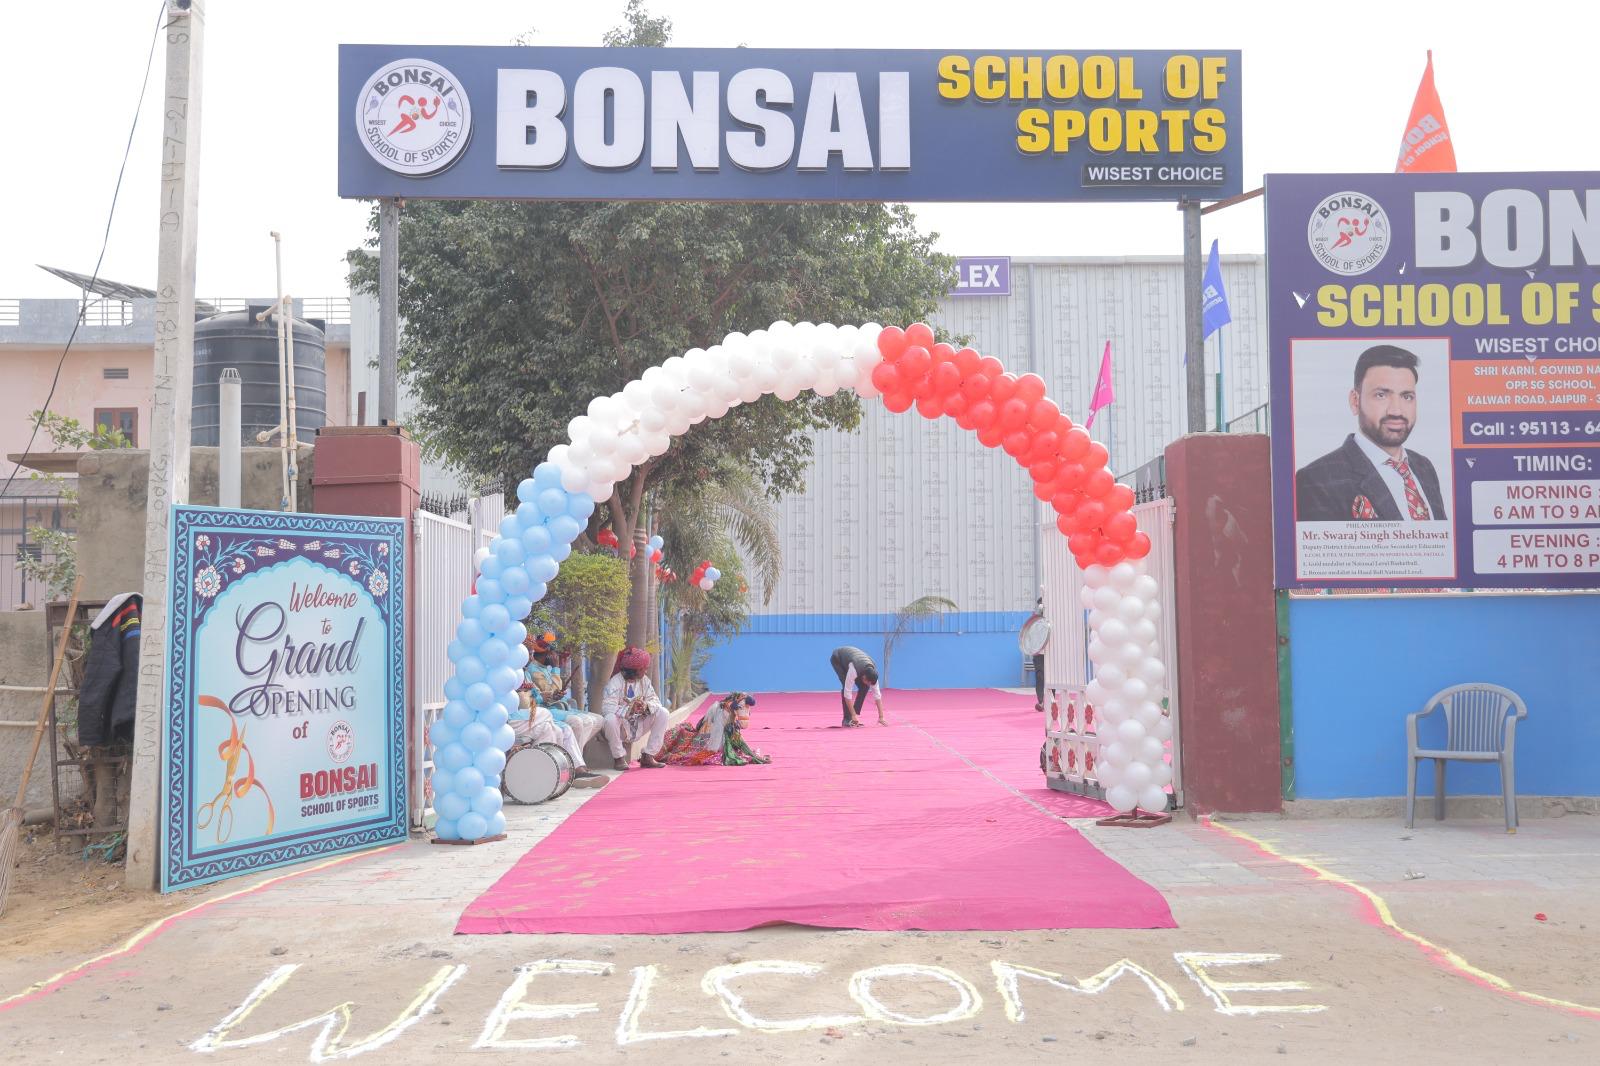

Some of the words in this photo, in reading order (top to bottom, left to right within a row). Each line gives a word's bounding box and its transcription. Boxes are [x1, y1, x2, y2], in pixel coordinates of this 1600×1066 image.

[373, 68, 454, 97] BONSAI
[937, 55, 1143, 100] SCHOOL
[1164, 55, 1228, 100] OF
[496, 67, 911, 171] BONSAI
[1017, 108, 1228, 154] SPORTS
[367, 127, 400, 161] SCHOOL
[404, 152, 418, 163] OF
[421, 130, 458, 162] SPORTS
[1088, 166, 1153, 181] WISEST
[1157, 166, 1223, 181] CHOICE
[1319, 196, 1379, 219] BONSAI
[1314, 242, 1340, 269] SCHOOL
[1343, 261, 1354, 270] OF
[1356, 243, 1384, 269] SPORTS
[1316, 283, 1510, 327] SCHOOL
[1521, 282, 1580, 326] OF
[1474, 337, 1549, 353] WISEST
[1474, 366, 1498, 376] SHRI
[1539, 365, 1583, 375] GOVIND
[1505, 380, 1528, 390] OPP.
[1530, 380, 1545, 389] SG
[1467, 395, 1511, 405] KALWAR
[1514, 394, 1547, 405] ROAD,
[1549, 393, 1587, 404] JAIPUR
[1470, 421, 1505, 436] Call
[1518, 420, 1570, 435] 95113
[1513, 454, 1593, 472] TIMING:
[1506, 484, 1592, 499] MORNING
[1493, 505, 1503, 520] 6
[1507, 505, 1535, 519] AM
[1540, 505, 1564, 519] TO
[1569, 504, 1579, 519] 9
[1302, 530, 1320, 540] Mr.
[1322, 530, 1357, 542] Swaraj
[1359, 530, 1390, 543] Singh
[1392, 529, 1448, 540] Shekhawat
[1510, 533, 1590, 548] EVENING
[1497, 554, 1507, 568] 4
[1512, 554, 1538, 568] PM
[1544, 554, 1568, 568] TO
[1573, 553, 1583, 568] 8
[289, 581, 359, 613] Welcome
[320, 617, 332, 635] to
[229, 601, 366, 713] Grand
[250, 685, 356, 716] OPENING
[292, 720, 309, 740] of
[299, 762, 378, 800] BONSAI
[301, 801, 335, 818] SCHOOL
[336, 799, 347, 811] OF
[347, 793, 379, 809] SPORTS
[189, 951, 1329, 1062] WELCOME
